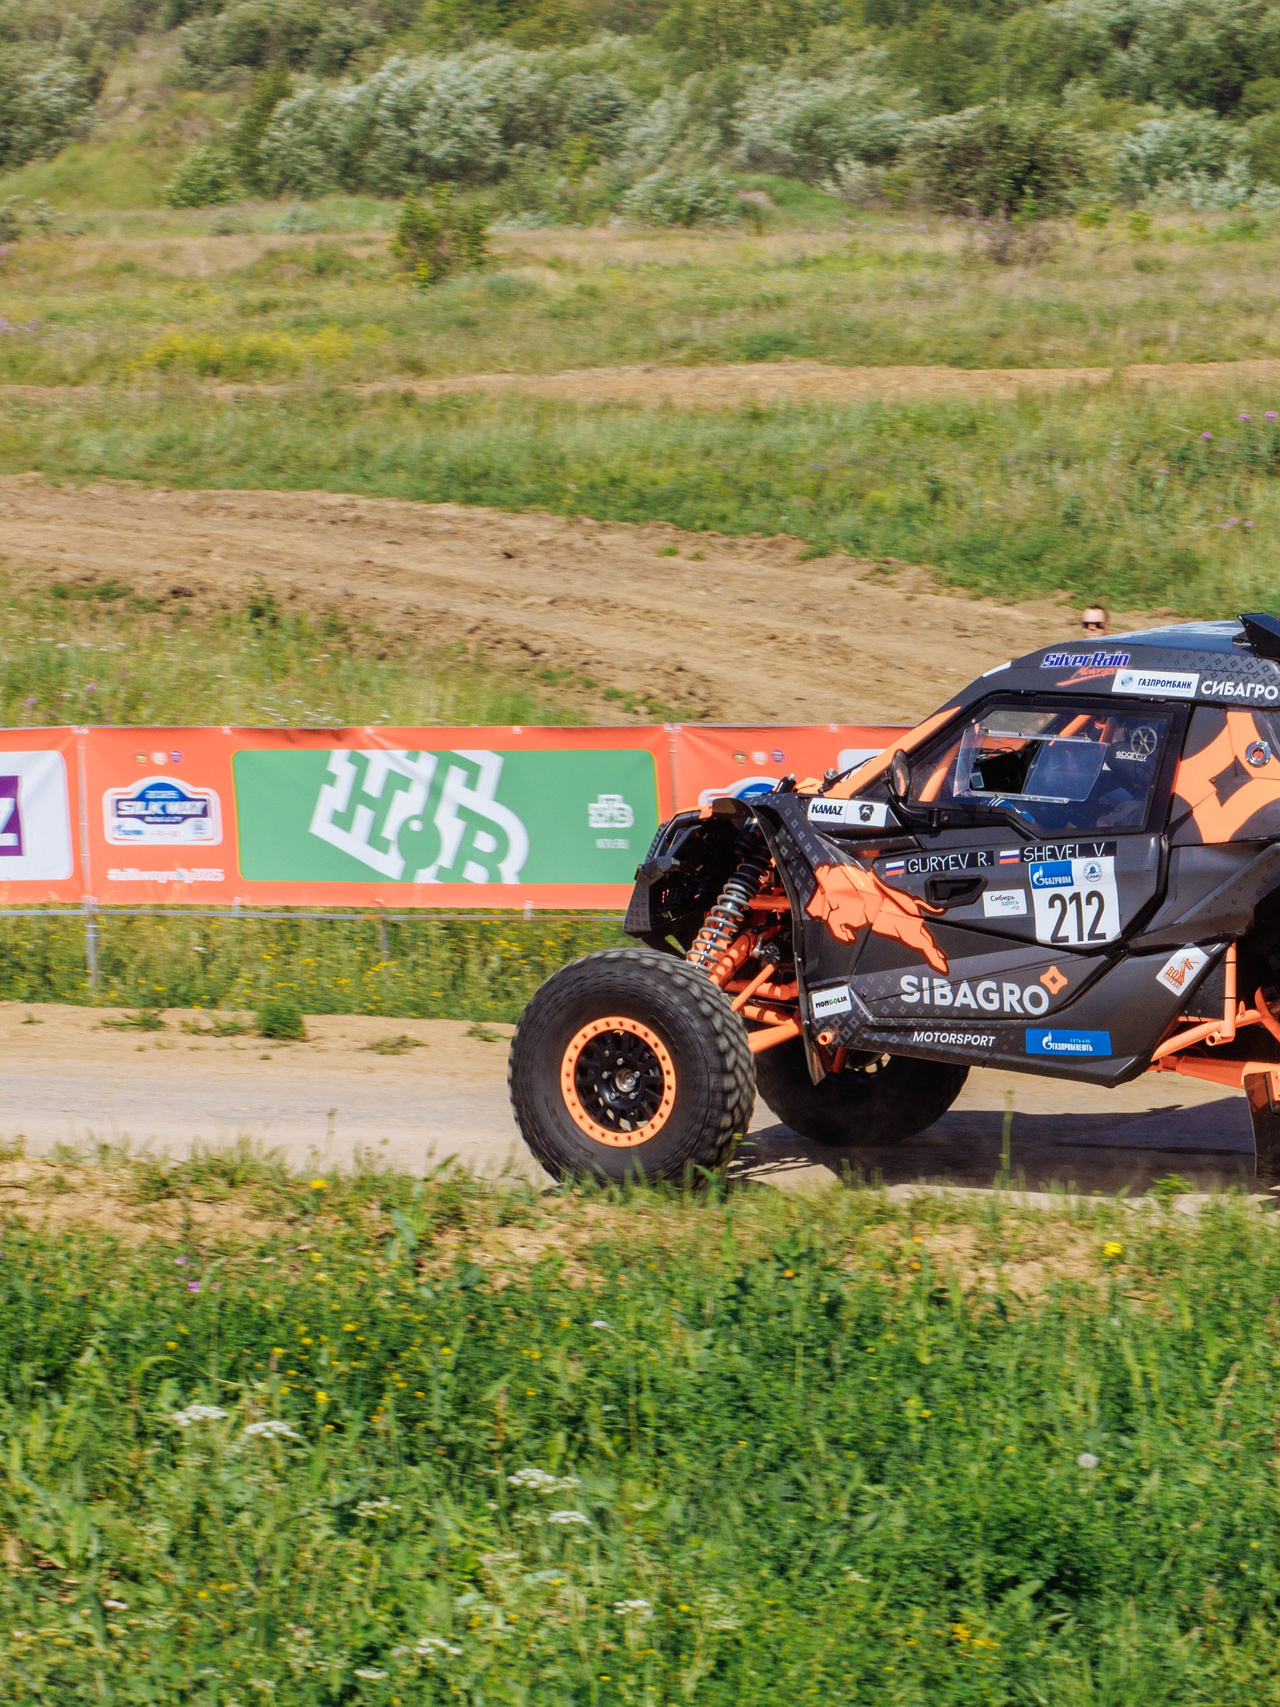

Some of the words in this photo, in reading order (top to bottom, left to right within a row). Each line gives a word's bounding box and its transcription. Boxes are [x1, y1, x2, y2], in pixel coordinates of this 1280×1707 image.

[1137, 677, 1192, 690] ГАЗПРОМБАНК
[1201, 680, 1279, 700] СИБАГРО
[811, 804, 843, 816] KAMAZ
[1023, 844, 1086, 862] SHEVEL
[1093, 842, 1106, 857] V.
[907, 854, 969, 874] GURYEV
[977, 851, 992, 867] R.
[1048, 890, 1107, 944] 212
[1166, 965, 1180, 979] 80
[815, 995, 848, 1009] MONGOLIA
[900, 974, 1050, 1015] SIBAGRO
[912, 1031, 996, 1047] MOTORSPORT
